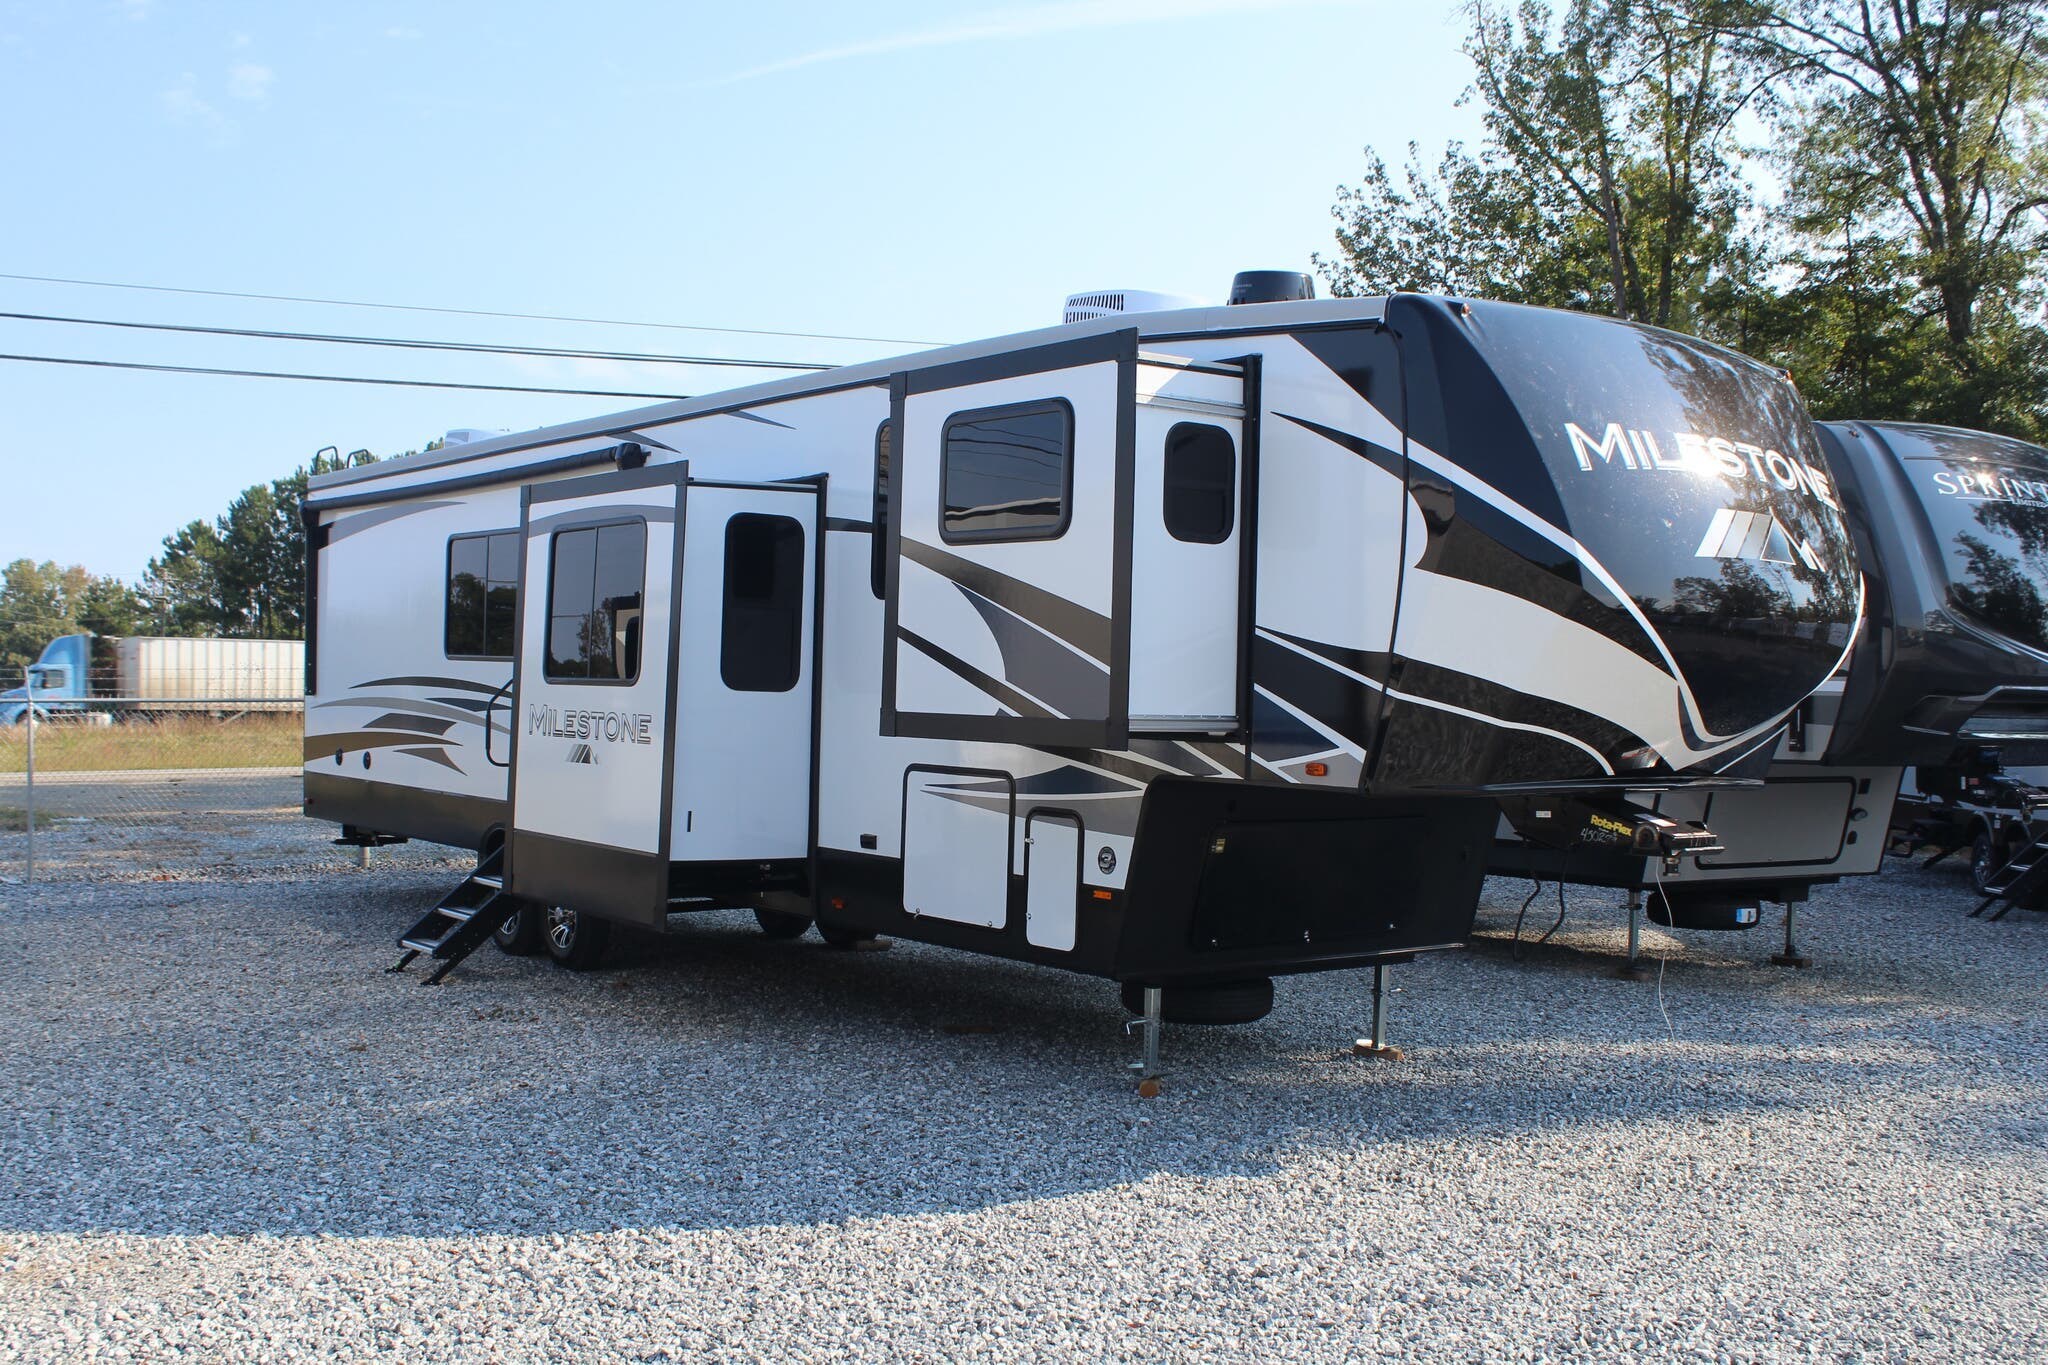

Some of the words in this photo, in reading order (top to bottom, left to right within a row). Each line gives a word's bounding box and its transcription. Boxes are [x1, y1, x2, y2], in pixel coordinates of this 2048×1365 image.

[1564, 422, 1839, 511] MILESTONE
[528, 704, 652, 744] MILESTONE
[1591, 814, 1633, 837] Rota-Flex
